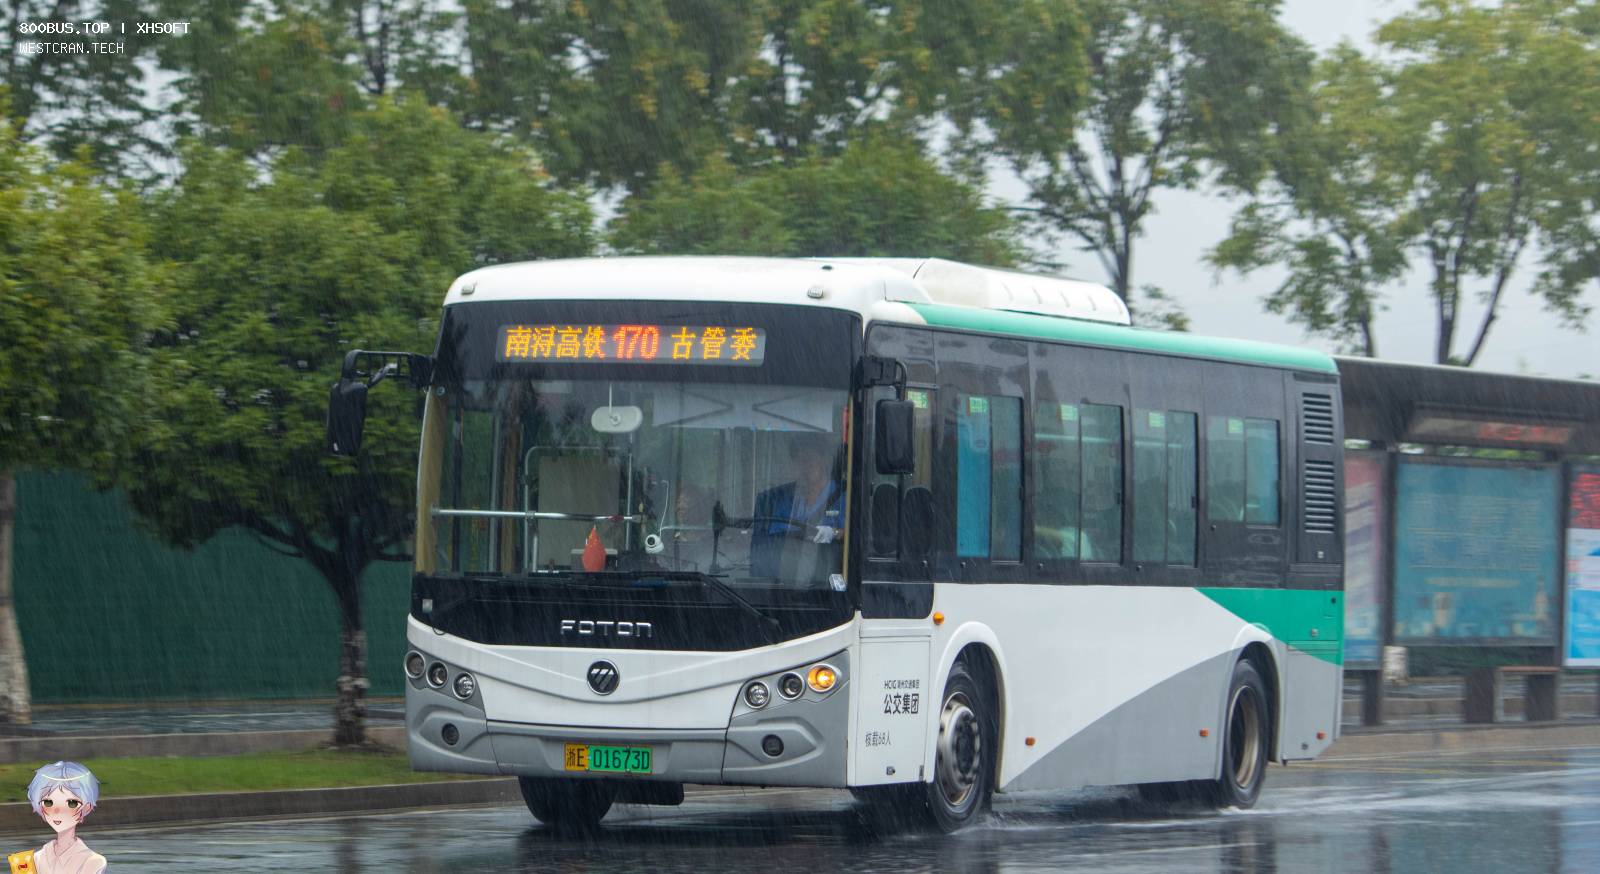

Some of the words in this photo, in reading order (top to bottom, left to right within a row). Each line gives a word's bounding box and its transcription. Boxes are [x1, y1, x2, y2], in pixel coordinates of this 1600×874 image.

[504, 325, 605, 360] 南浔高铁
[613, 325, 660, 360] 170
[671, 326, 758, 361] 古管委
[560, 619, 652, 638] FOTON
[884, 693, 919, 714] 公交集团
